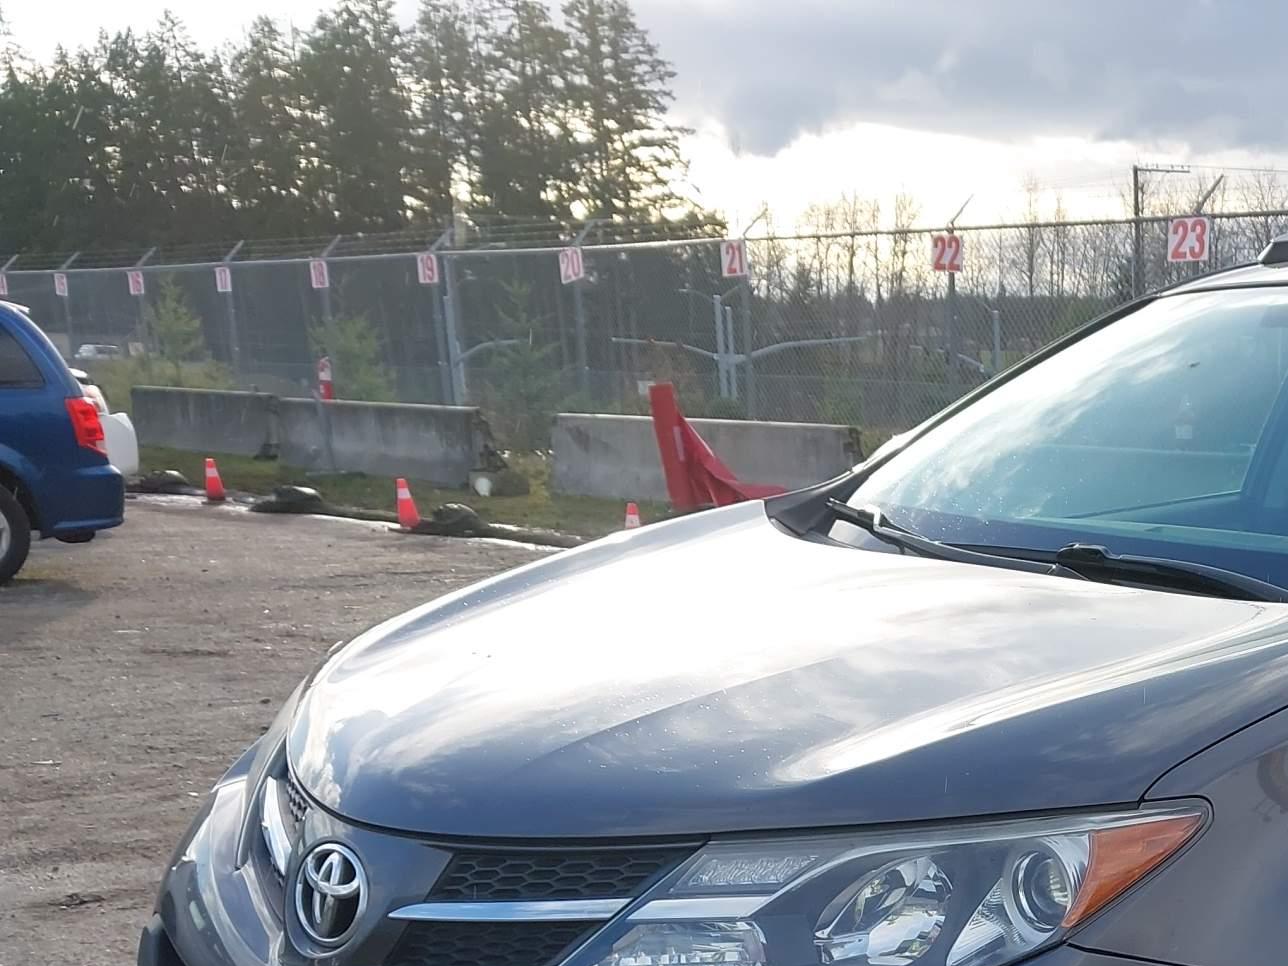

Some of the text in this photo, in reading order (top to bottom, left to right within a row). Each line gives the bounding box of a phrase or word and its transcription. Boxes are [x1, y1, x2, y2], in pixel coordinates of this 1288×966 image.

[932, 235, 961, 271] 22
[1170, 217, 1207, 260] 23
[420, 255, 433, 281] 19
[561, 249, 580, 281] 20
[724, 242, 744, 275] 21
